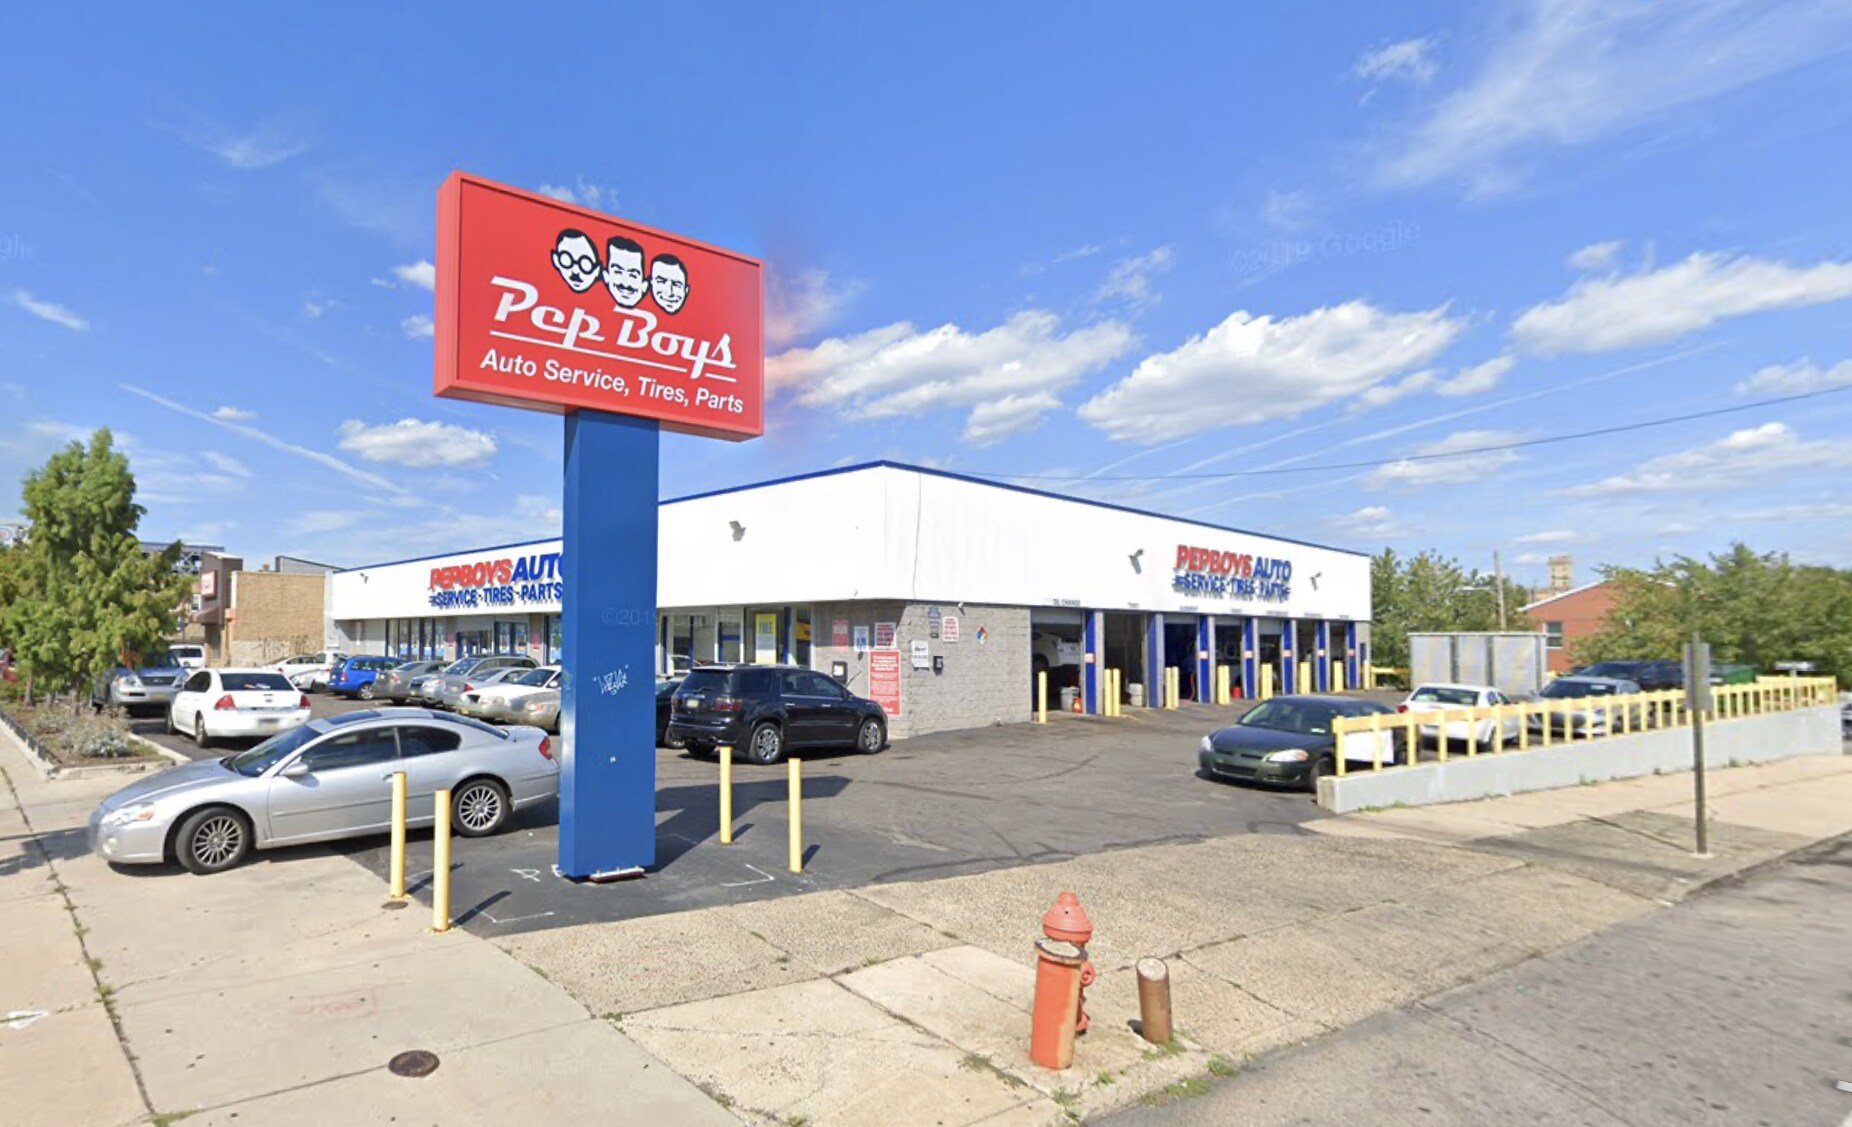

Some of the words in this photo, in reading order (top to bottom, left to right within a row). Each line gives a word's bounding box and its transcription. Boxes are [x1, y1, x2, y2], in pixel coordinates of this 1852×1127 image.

[490, 275, 606, 347] Pep
[613, 305, 737, 379] Boys
[480, 348, 537, 377] Auto
[543, 358, 630, 397] Service,
[638, 375, 690, 405] Tires,
[695, 386, 744, 414] Parts
[511, 552, 562, 582] AUT
[483, 586, 514, 603] TIRES
[520, 582, 563, 601] PARTS
